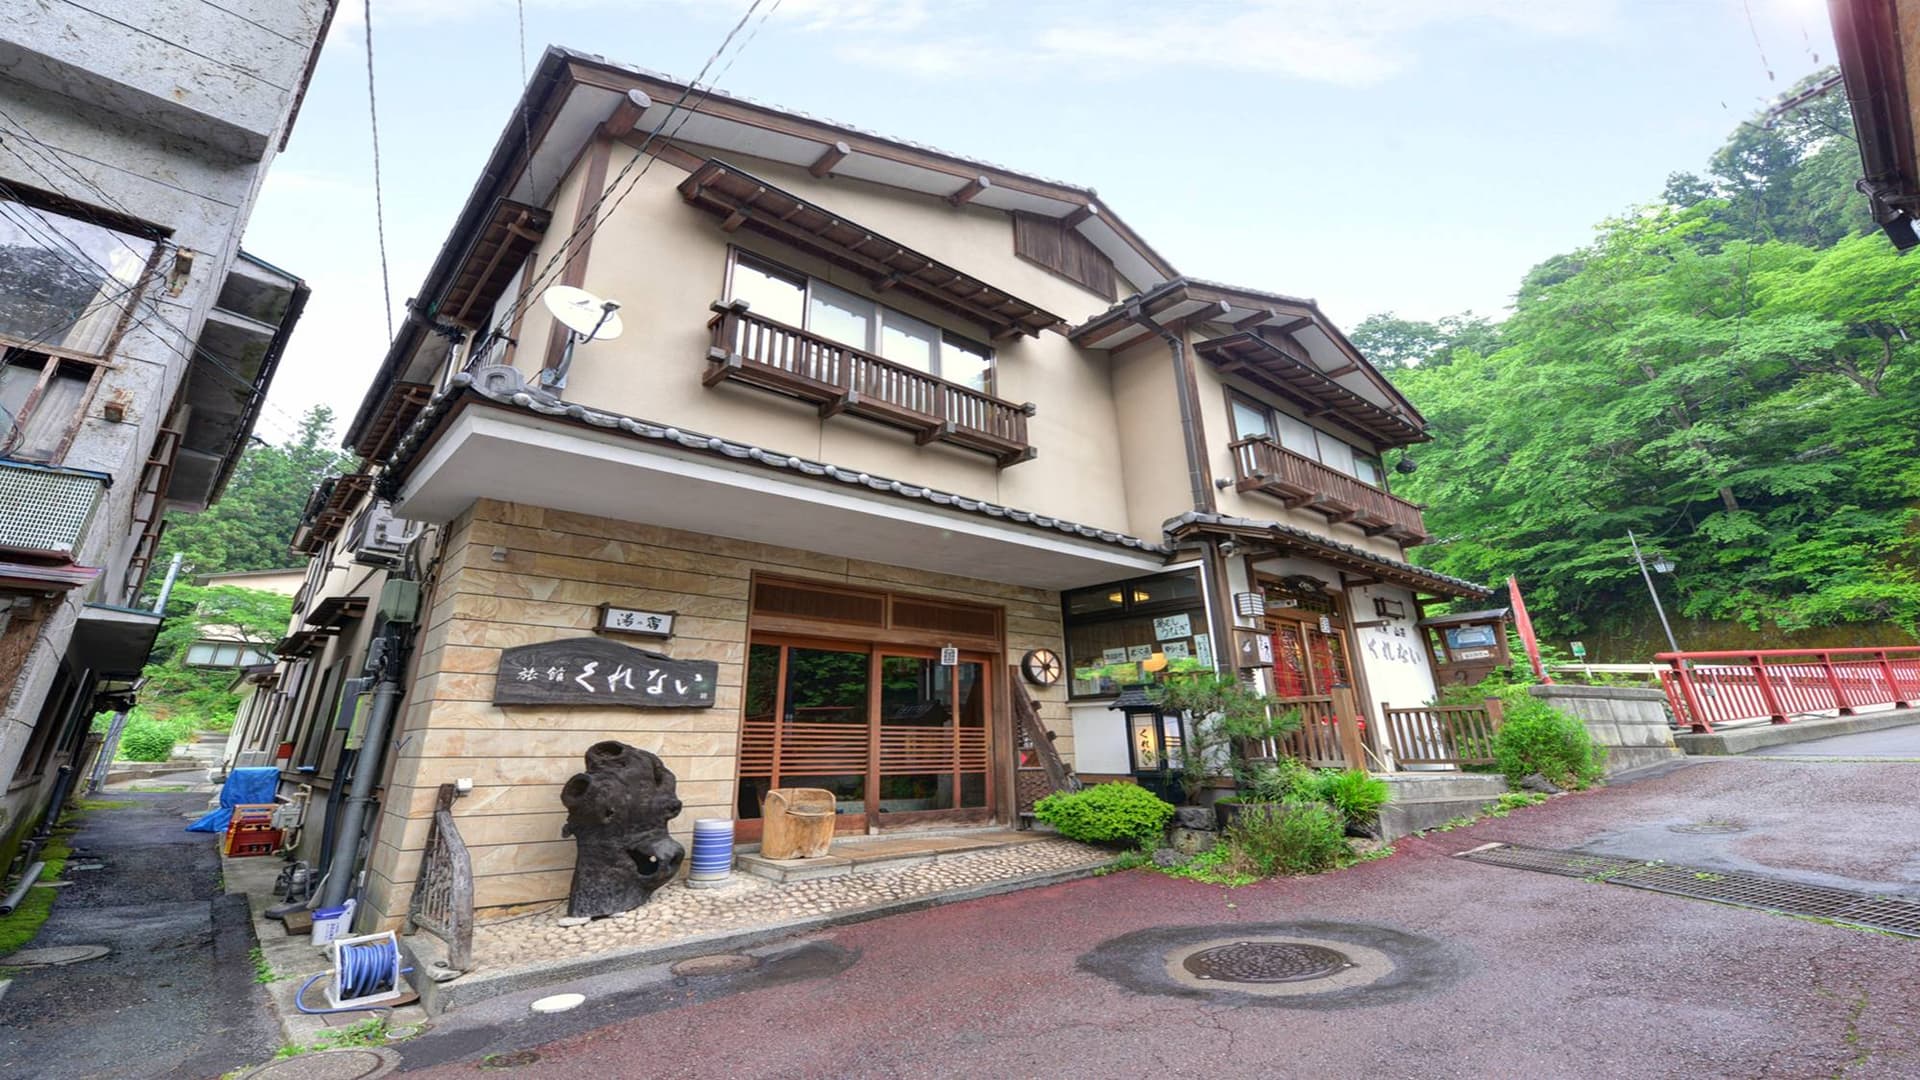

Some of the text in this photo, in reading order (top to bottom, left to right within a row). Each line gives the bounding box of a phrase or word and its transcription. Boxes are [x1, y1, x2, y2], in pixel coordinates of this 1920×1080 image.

[616, 612, 662, 631] 湯の宿
[1367, 637, 1421, 665] くれない
[517, 661, 702, 694] 旅館 くれない
